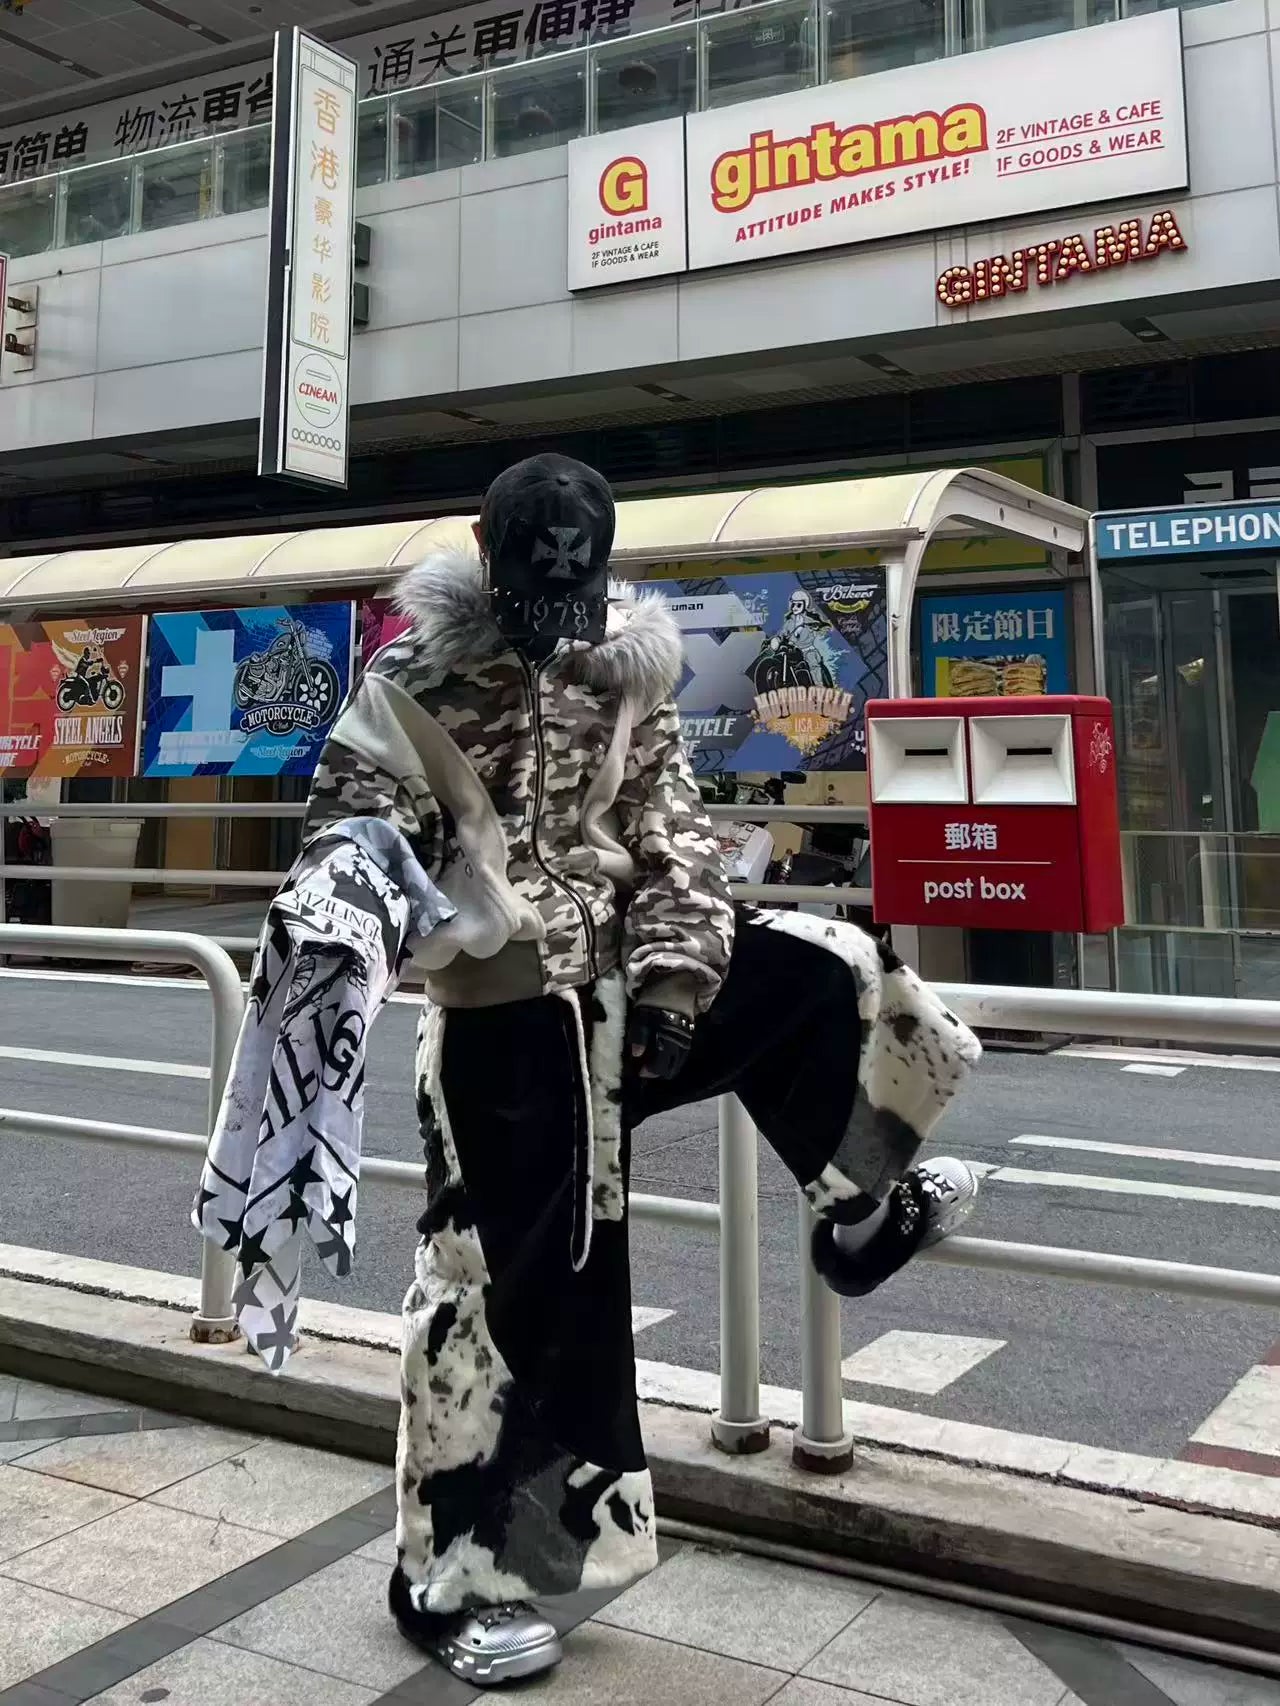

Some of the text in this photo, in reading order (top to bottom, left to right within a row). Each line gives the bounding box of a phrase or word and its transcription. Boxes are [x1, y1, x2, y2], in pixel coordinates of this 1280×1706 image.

[997, 100, 1161, 144] 2F VINTAGE & CAFE
[711, 103, 988, 213] gintama
[1018, 143, 1083, 167] GOODS
[1089, 140, 1101, 154] &
[1109, 129, 1162, 151] WEAR
[599, 156, 648, 216] G
[735, 158, 970, 242] ATTITUDE MAKES STYLE!
[588, 216, 662, 245] gintama
[591, 241, 660, 260] 2F VINTAGE & CAFE
[601, 254, 628, 267] GOODS
[629, 253, 636, 261] &
[638, 249, 660, 260] WEAR
[936, 210, 1188, 307] GINTAMA
[1106, 512, 1280, 550] TELEPHON
[522, 596, 590, 634] 1978
[931, 608, 1055, 644] 限定節日
[54, 716, 123, 745] STEEL ANGELS
[247, 705, 314, 725] MOTORCYCLE
[944, 822, 998, 850] 郵箱
[923, 875, 1026, 904] post box
